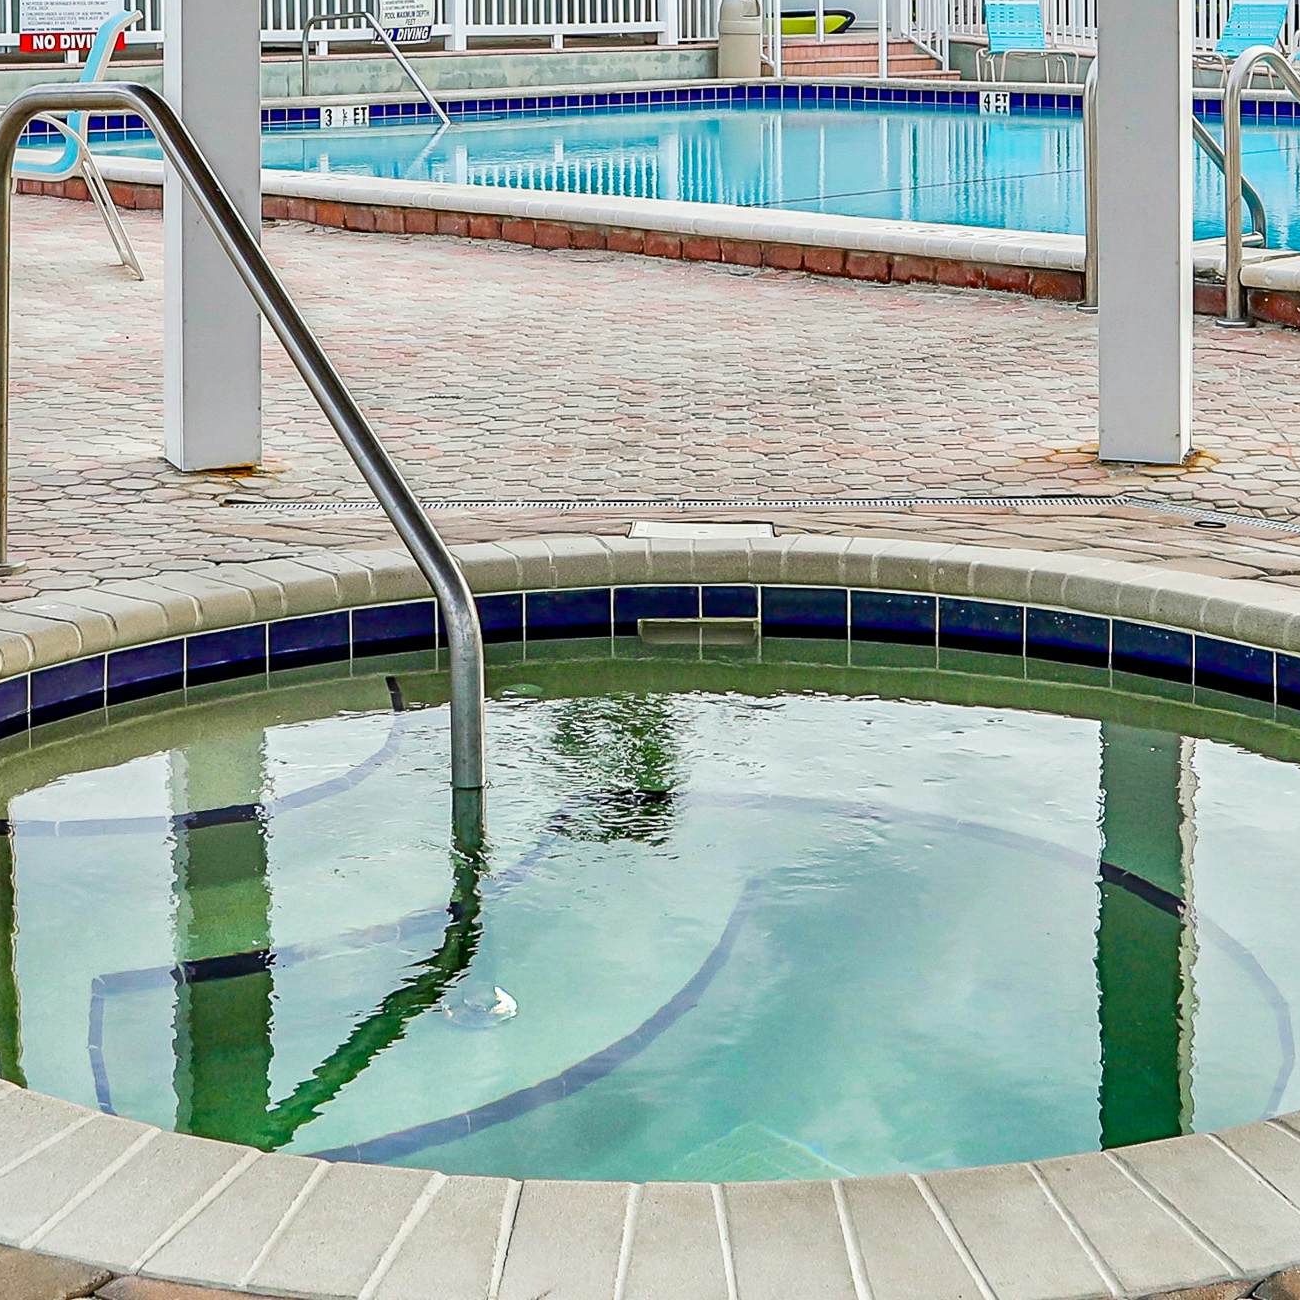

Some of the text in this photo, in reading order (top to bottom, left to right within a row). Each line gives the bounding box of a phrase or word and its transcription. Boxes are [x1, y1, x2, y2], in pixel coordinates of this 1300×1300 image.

[32, 34, 97, 50] NO DIVI
[396, 26, 430, 42] DIVING
[324, 108, 333, 126] 3
